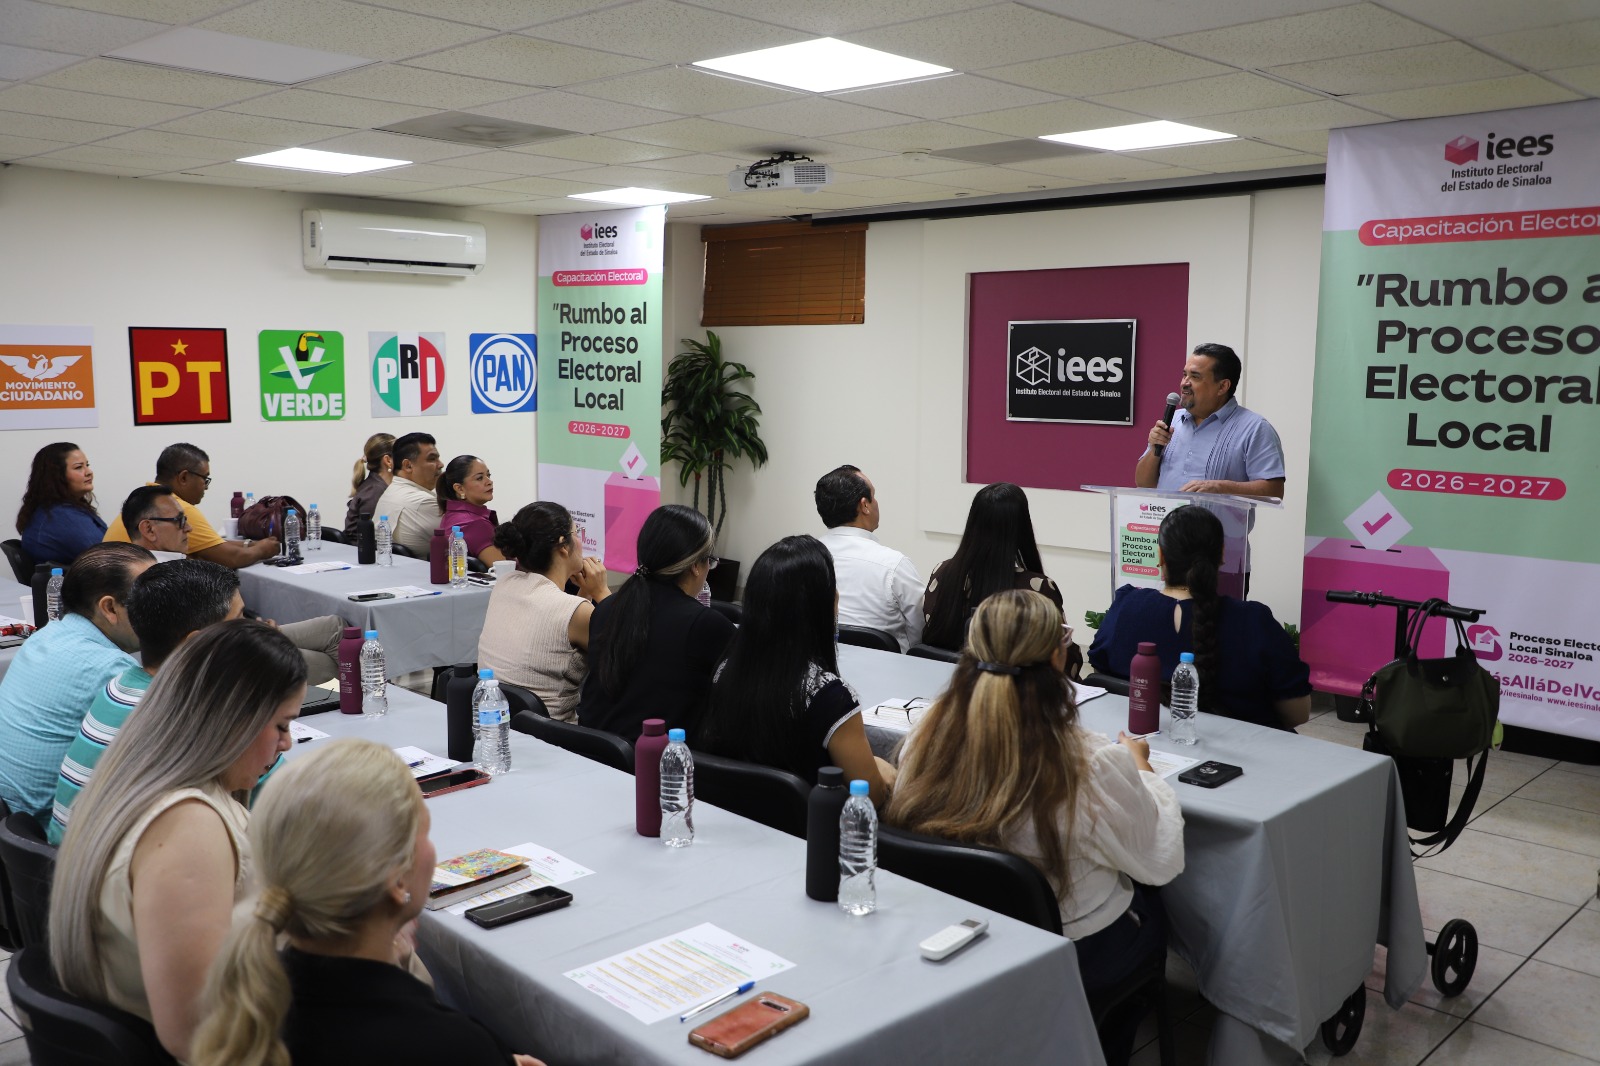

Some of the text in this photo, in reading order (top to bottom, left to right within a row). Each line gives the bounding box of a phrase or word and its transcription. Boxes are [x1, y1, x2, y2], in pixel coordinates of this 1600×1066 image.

[1486, 133, 1554, 160] iees
[1451, 162, 1544, 178] Instituto Electoral
[1441, 174, 1552, 192] del Estado de Sinaloa
[594, 223, 618, 239] iees
[1373, 216, 1514, 242] Capacitación
[557, 270, 644, 284] Capacitación Electoral
[630, 302, 647, 324] al
[561, 331, 638, 354] Proceso
[1376, 320, 1600, 354] Proceso
[378, 344, 437, 394] PRI
[482, 354, 526, 392] PAN
[558, 358, 642, 383] Electoral
[1056, 348, 1123, 382] iees
[0, 390, 84, 402] CIUDADANO
[6, 381, 76, 390] MOVIMIENTO
[139, 360, 222, 416] PT
[264, 393, 342, 418] VERDE
[574, 386, 624, 412] Local
[572, 422, 625, 436] 2026-2027
[1407, 412, 1552, 453] Local
[1400, 472, 1551, 496] 2026-2027
[1150, 504, 1166, 512] iees
[1122, 542, 1152, 550] Proceso
[1122, 550, 1155, 558] Electoral
[1510, 632, 1561, 646] Proceso
[1509, 642, 1593, 661] Local Sinaloa
